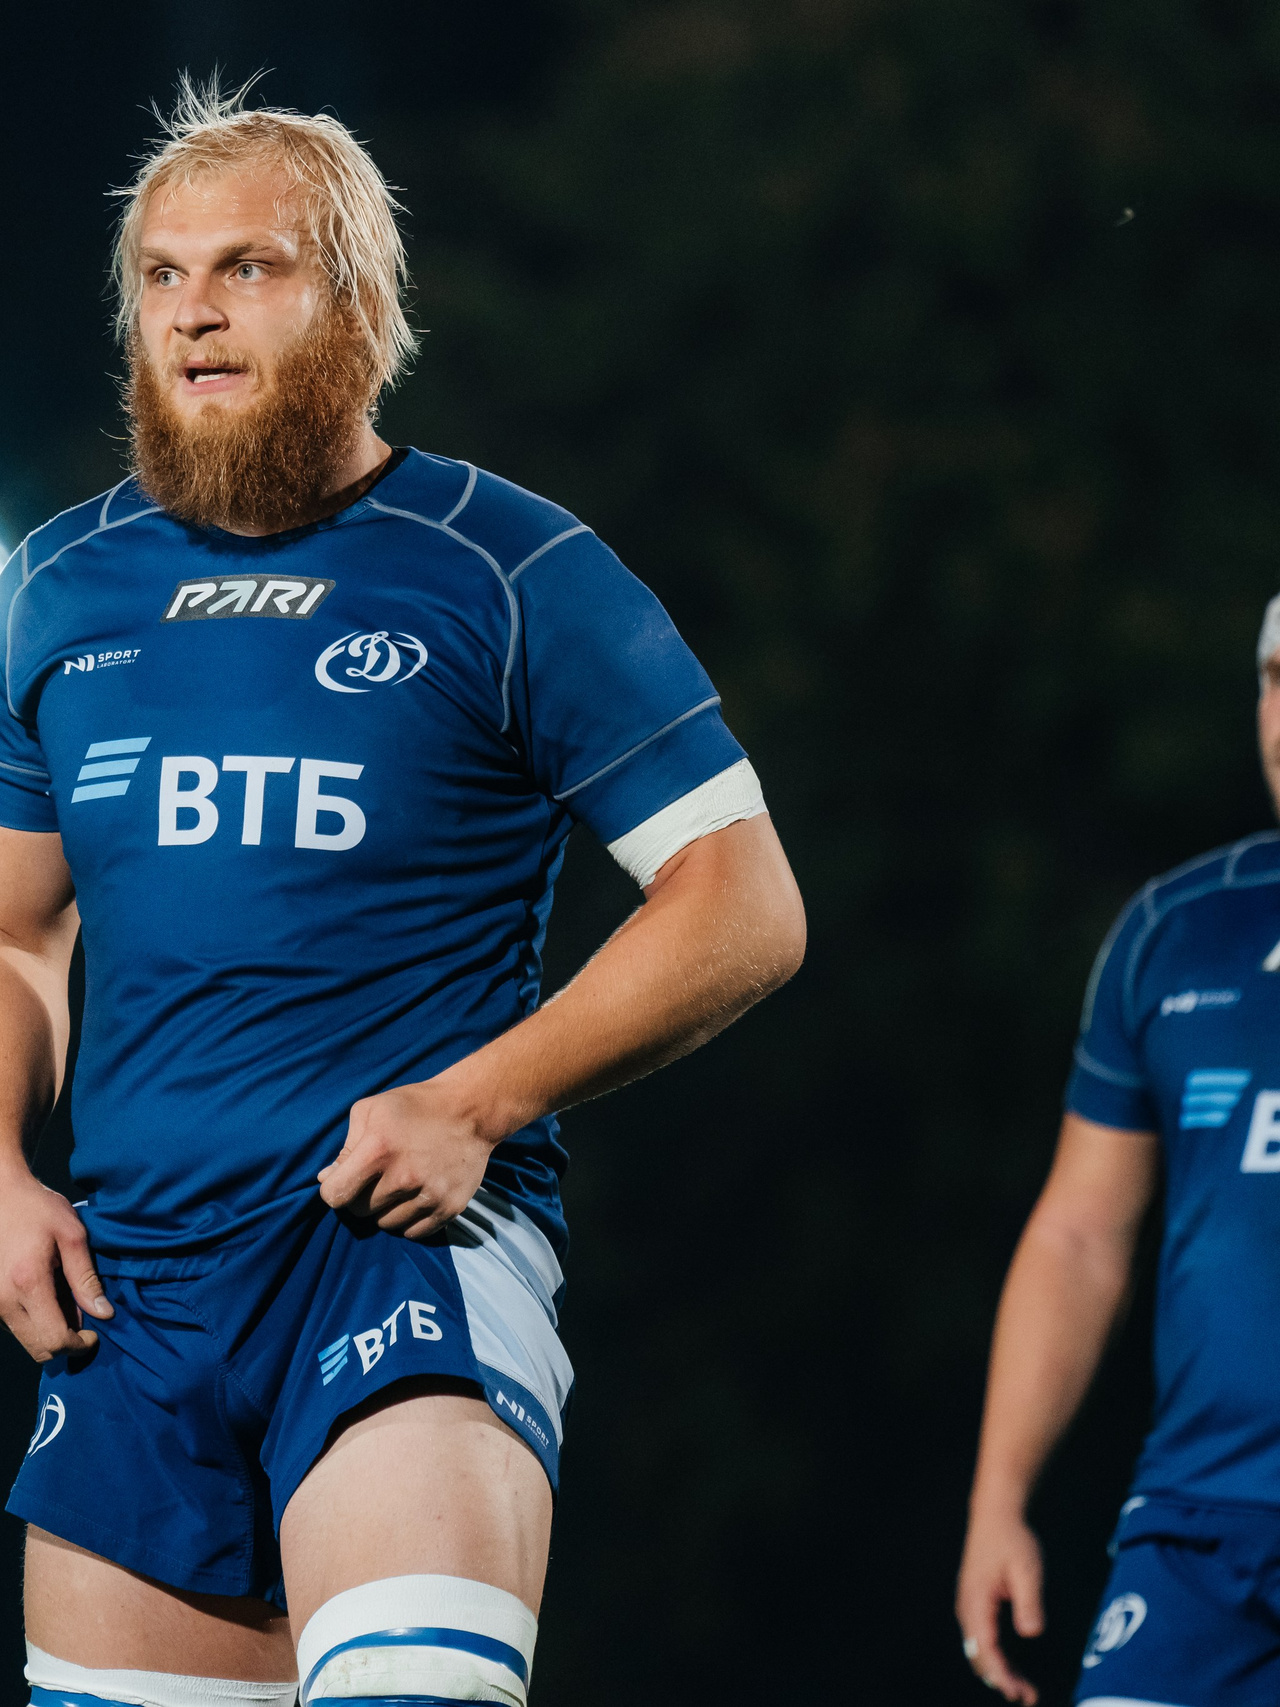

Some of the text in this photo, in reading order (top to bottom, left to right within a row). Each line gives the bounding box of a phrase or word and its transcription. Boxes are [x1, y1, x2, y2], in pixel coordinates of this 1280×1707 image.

[166, 580, 325, 619] PARI
[96, 659, 136, 669] LABORATORY
[98, 649, 142, 663] SPORT
[158, 755, 367, 852] ВТБ
[353, 1300, 443, 1376] ВТБ
[526, 1415, 549, 1446] SPORT
